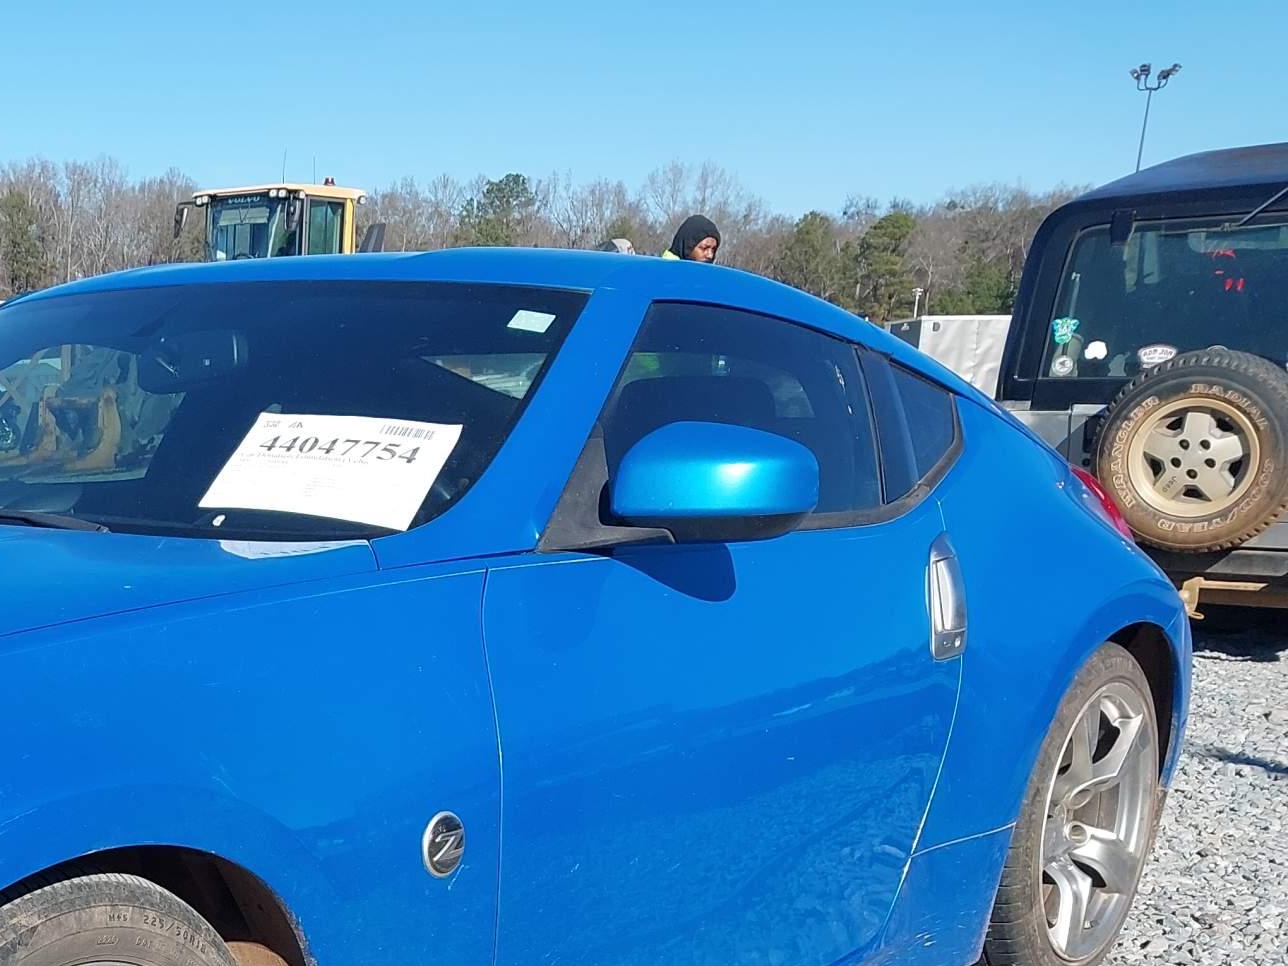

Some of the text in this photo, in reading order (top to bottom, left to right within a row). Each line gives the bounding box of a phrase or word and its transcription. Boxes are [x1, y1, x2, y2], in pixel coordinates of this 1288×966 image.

[228, 195, 261, 204] VOLVO
[1189, 383, 1269, 431] RADIAL
[259, 435, 421, 464] 44047754
[1110, 395, 1160, 508] WRANGLER
